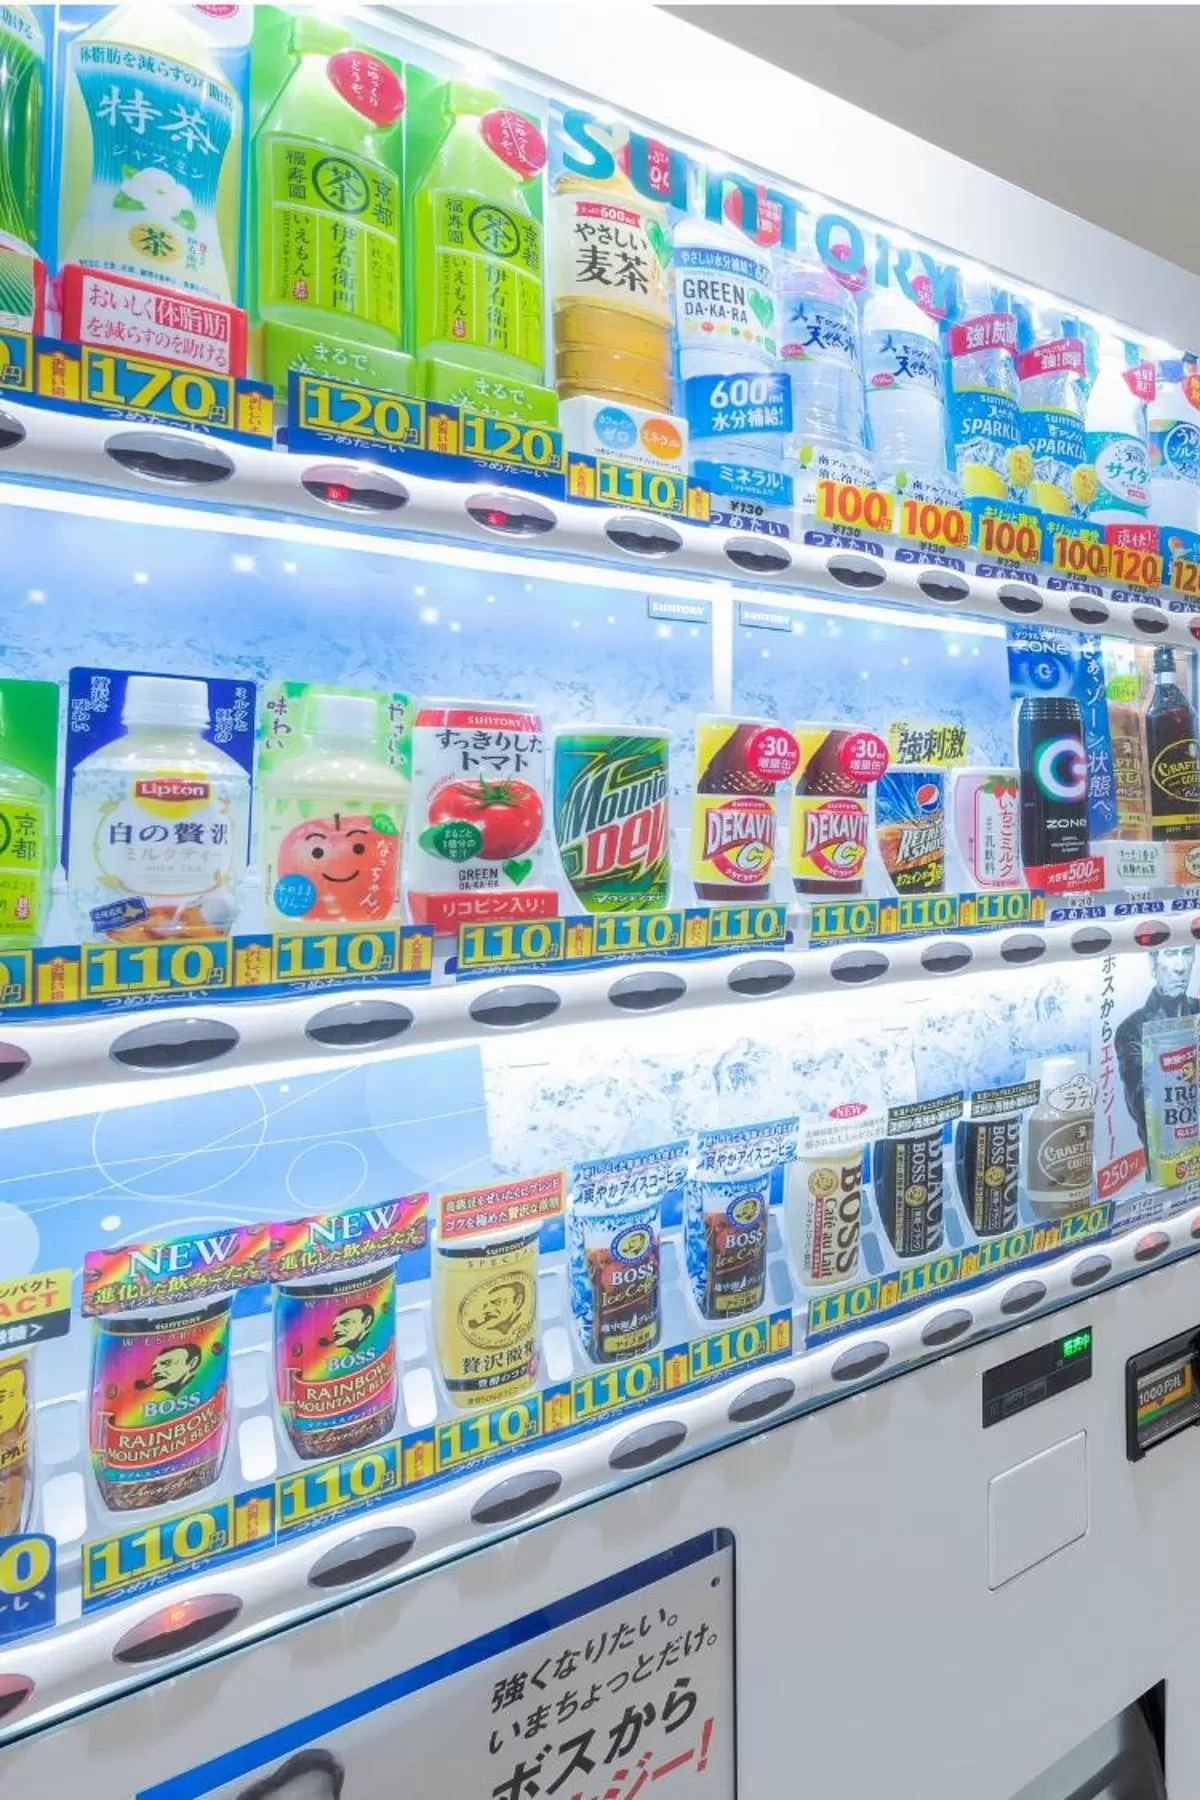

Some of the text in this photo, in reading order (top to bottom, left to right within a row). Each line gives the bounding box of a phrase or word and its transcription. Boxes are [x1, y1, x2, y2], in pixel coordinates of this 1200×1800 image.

[96, 84, 220, 155] 特茶
[324, 165, 362, 206] 茶
[369, 178, 393, 228] 京都
[139, 227, 174, 257] 茶
[480, 212, 513, 251] 茶
[574, 223, 648, 250] やさしい
[575, 245, 648, 295] 麦茶
[682, 278, 745, 306] GREEN
[86, 315, 227, 368] を減らすのを助ける
[710, 379, 784, 409] 600ml
[712, 406, 784, 432] 水分補給!
[719, 468, 785, 491] ミネラル!
[710, 511, 783, 536] つめたい
[812, 533, 878, 555] つめたい
[902, 551, 961, 570] つめたい
[982, 566, 1035, 584] つめたい
[265, 699, 292, 749] 味わい
[387, 702, 406, 766] やさしい
[467, 716, 522, 728] SUNTORY
[436, 728, 543, 754] すっきりした
[898, 729, 967, 764] 強刺激
[462, 752, 530, 773] トマト
[139, 781, 205, 798] Lipton
[12, 813, 37, 862] 京都
[108, 821, 229, 846] 白の贅沢
[999, 801, 1014, 878] いちごミルク
[458, 868, 499, 881] GREEN
[911, 1142, 926, 1184] BOSS
[992, 1125, 1006, 1165] BOSS
[308, 1202, 400, 1247] NEW
[836, 1166, 862, 1274] BOSS
[128, 1232, 239, 1279] NEW
[725, 1229, 764, 1250] BOSS
[95, 1258, 259, 1305] 進化した飲みごたえ
[611, 1261, 655, 1287] BOSS
[327, 1346, 377, 1373] BOSS
[305, 1362, 388, 1401] RAINBOW
[143, 1391, 201, 1418] BOSS
[118, 1403, 216, 1450] RAINBOW
[491, 1607, 678, 1714] 強くなりたい。
[489, 1622, 718, 1755] いまちょっとだけ。
[491, 1677, 698, 1800] ボスから
